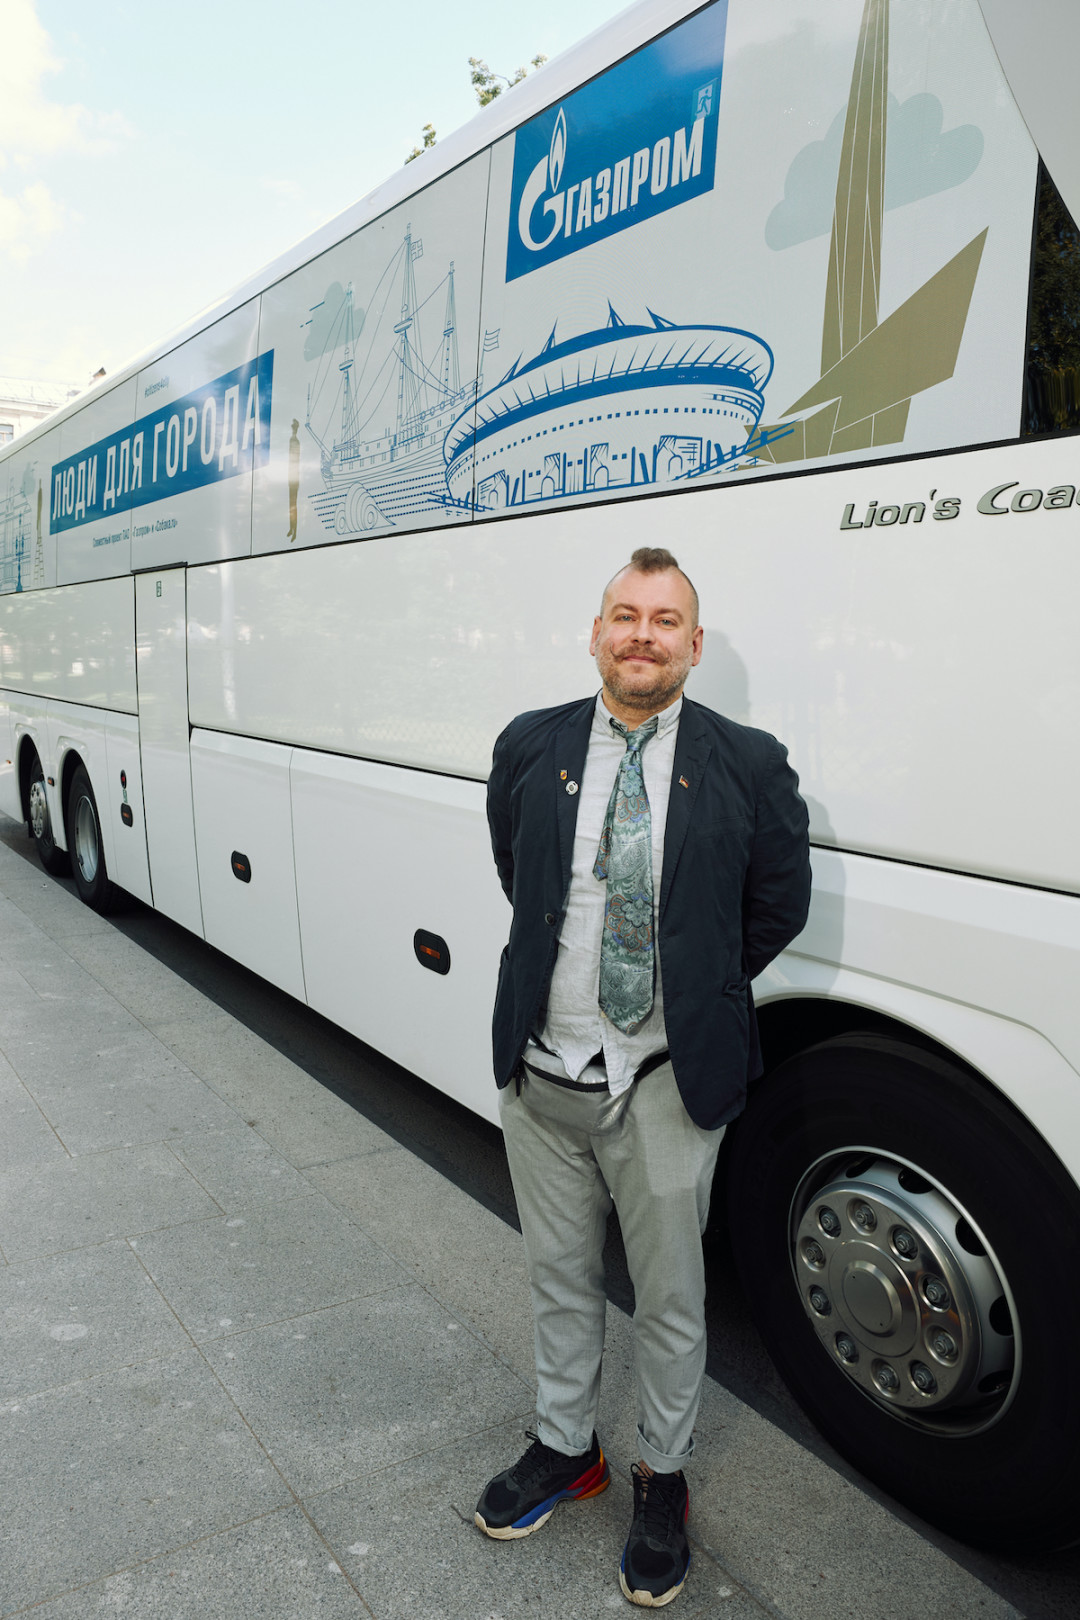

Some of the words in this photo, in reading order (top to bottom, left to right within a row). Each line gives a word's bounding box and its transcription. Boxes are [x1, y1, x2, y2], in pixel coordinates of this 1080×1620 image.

[564, 117, 705, 238] ГАЗПРОМ
[52, 454, 98, 521] ЛЮДИ
[103, 431, 144, 511] ДЛЯ
[152, 374, 261, 483] ГОРОДА
[839, 488, 962, 530] Lion's
[976, 481, 1080, 515] Coa
